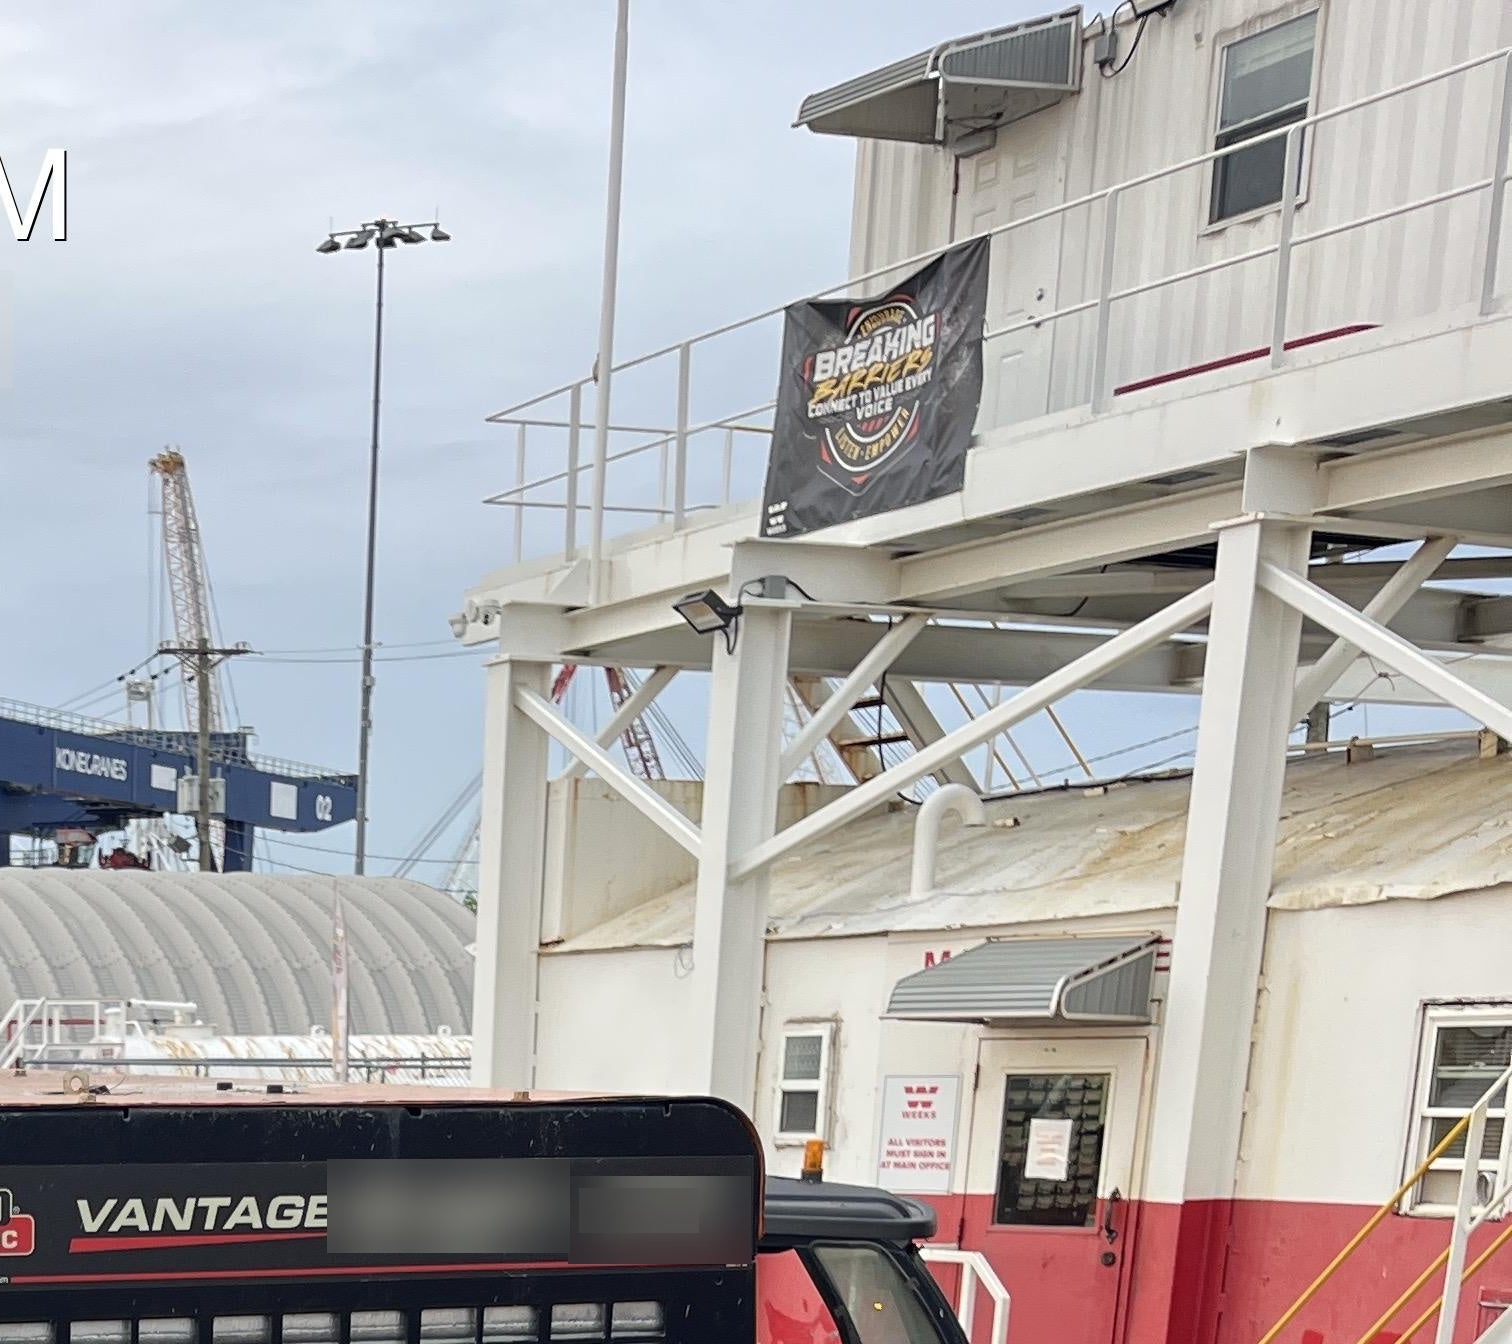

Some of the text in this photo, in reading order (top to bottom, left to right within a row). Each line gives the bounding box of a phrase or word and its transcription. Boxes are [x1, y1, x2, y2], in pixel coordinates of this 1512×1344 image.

[813, 314, 936, 382] BREAKING
[808, 346, 934, 404] BARRIERS
[807, 394, 858, 419] CONNECT
[859, 388, 872, 406] TO
[872, 377, 904, 399] VALUE
[855, 397, 894, 420] VOICE
[55, 747, 128, 782] KONECRANES
[901, 1110, 937, 1120] WEEKS
[886, 1149, 947, 1158] MUST SIGN IN
[888, 1138, 947, 1148] ALL VISITORS
[879, 1161, 952, 1171] AT MAIN OFFICE
[76, 1194, 328, 1234] VANTAGE
